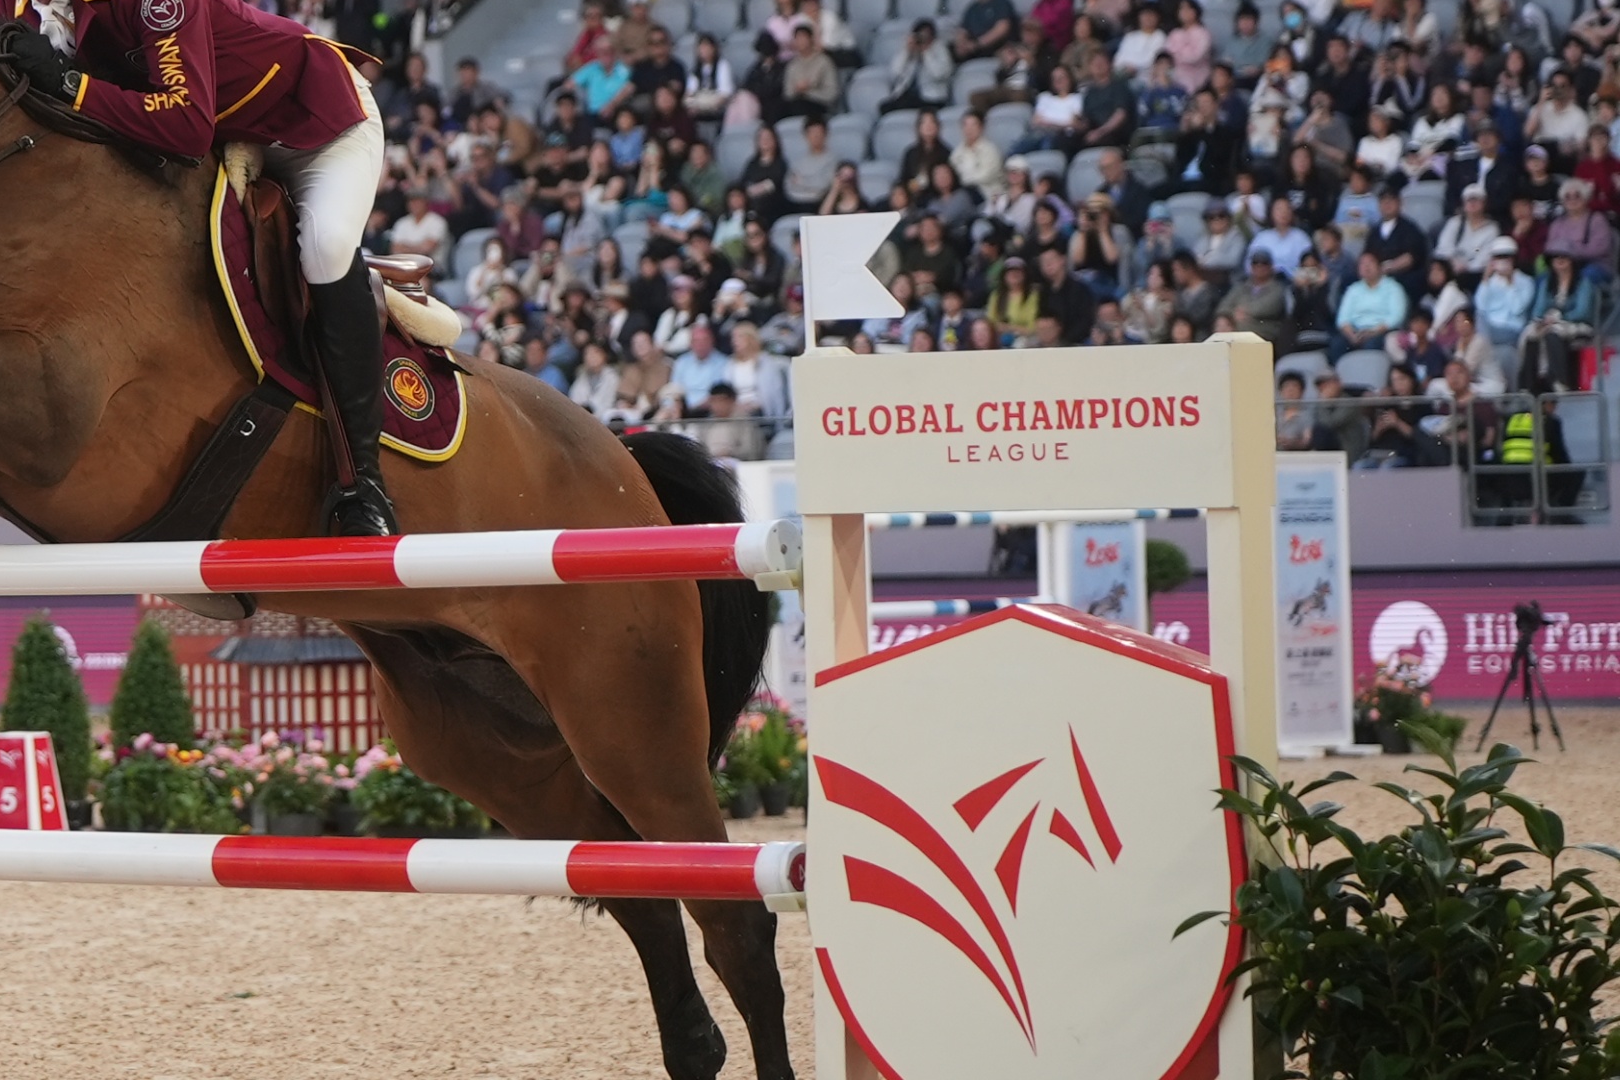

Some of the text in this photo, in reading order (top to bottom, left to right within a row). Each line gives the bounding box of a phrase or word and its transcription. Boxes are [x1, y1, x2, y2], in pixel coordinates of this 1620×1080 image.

[155, 32, 186, 85] SWAN
[822, 395, 1200, 436] GLOBAL CHAMPIONS
[948, 443, 1069, 463] LEAGUE
[0, 786, 18, 814] 5
[41, 785, 55, 813] 5
